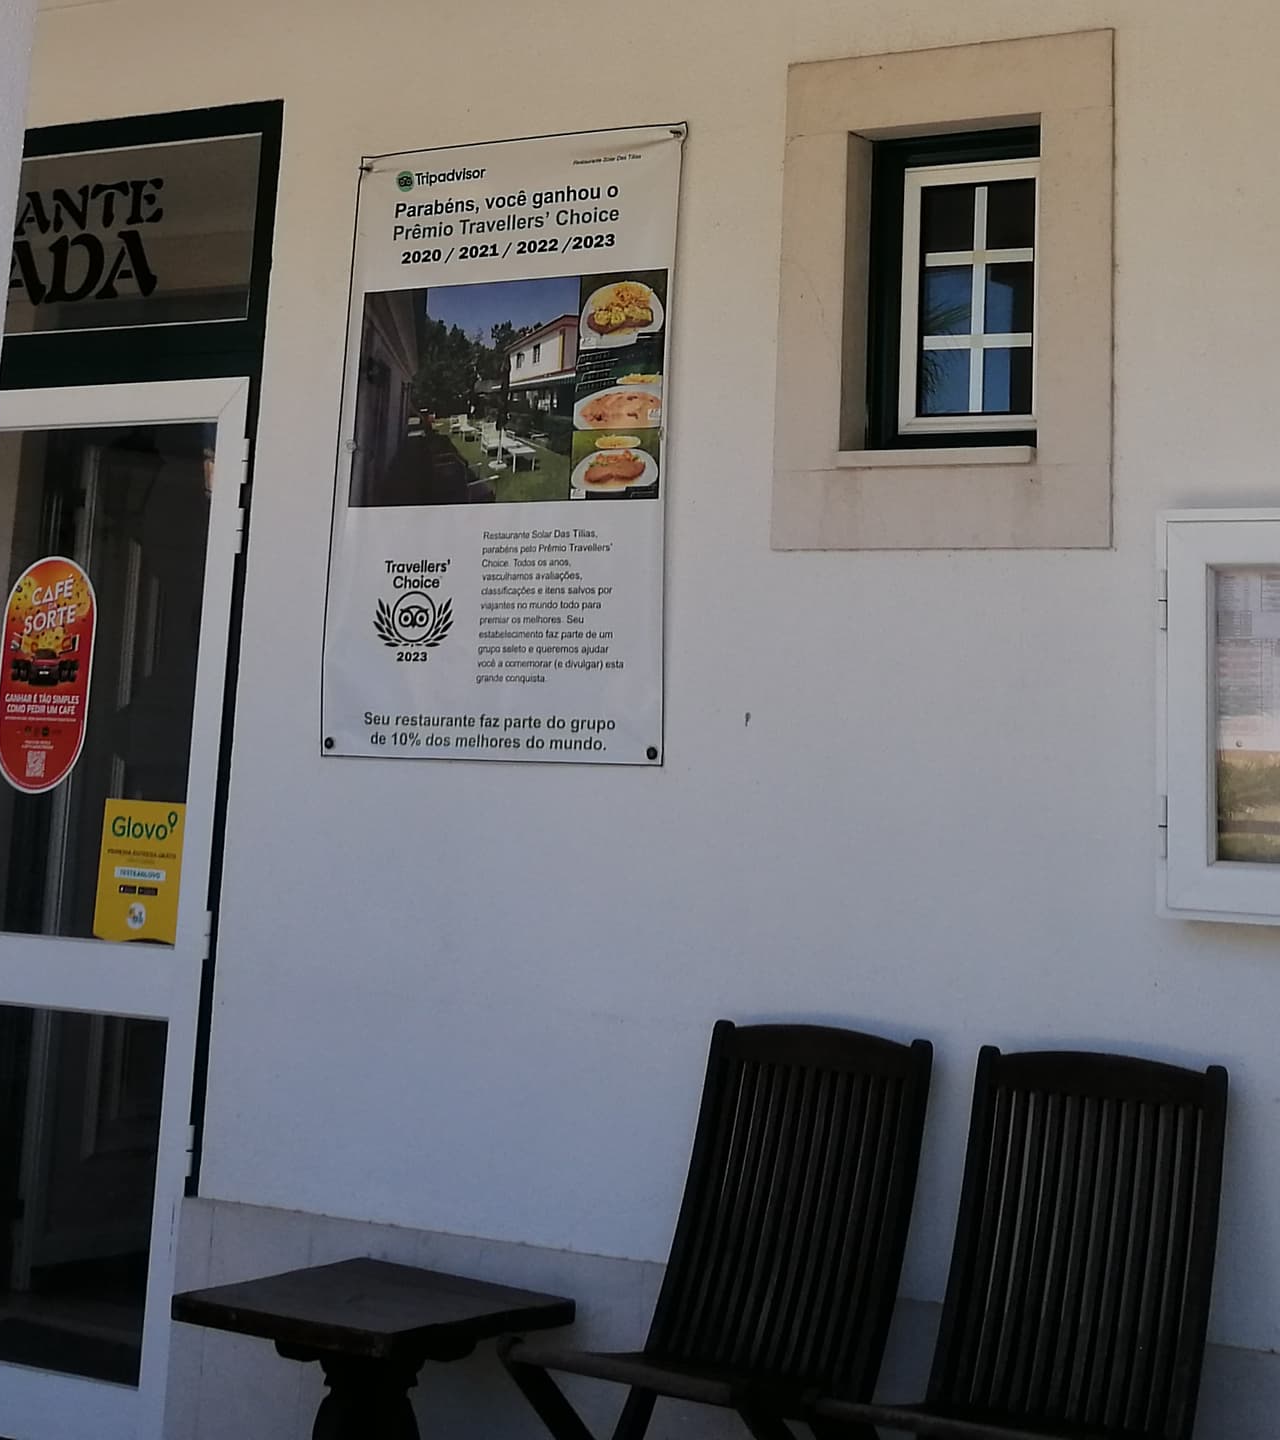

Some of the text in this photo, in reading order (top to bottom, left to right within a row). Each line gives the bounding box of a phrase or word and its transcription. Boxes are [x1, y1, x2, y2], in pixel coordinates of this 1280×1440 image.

[415, 167, 486, 187] Tripadvisor
[394, 185, 619, 218] Parabéns, você ganhou o
[393, 221, 454, 241] Prêmio
[556, 207, 620, 226] Choice
[401, 248, 442, 264] 2020
[458, 243, 499, 260] 2021
[516, 238, 559, 255] 2022
[483, 531, 530, 540] Restaurante
[532, 530, 552, 539] Solar
[554, 529, 571, 538] Das
[482, 545, 518, 555] parabéns
[520, 543, 537, 554] pelo
[513, 558, 536, 567] Todos
[393, 575, 440, 589] Choice
[31, 573, 74, 606] CAFÉ
[545, 586, 565, 594] itens
[568, 585, 596, 595] salvos
[598, 587, 613, 596] por
[517, 601, 528, 609] no
[529, 600, 558, 609] mundo
[560, 600, 580, 609] todo
[581, 602, 601, 610] para
[24, 604, 77, 634] SORTE
[479, 615, 510, 625] premiar
[566, 614, 584, 624] Seu
[478, 629, 613, 640] estabelecimento faz parte de um
[478, 646, 501, 655] grupo
[502, 645, 526, 653] seleto
[536, 646, 579, 655] queremos
[581, 645, 609, 655] ajudar
[396, 651, 427, 662] 2023
[477, 659, 496, 668] você
[505, 660, 552, 668] comemorar
[565, 660, 603, 670] divulgar)
[605, 660, 624, 669] esta
[476, 674, 504, 684] grande
[364, 712, 616, 733] Seu restaurante faz parte do grupo
[370, 731, 607, 751] de 10% dos melhores do mundo.
[112, 815, 168, 840] Glovo
